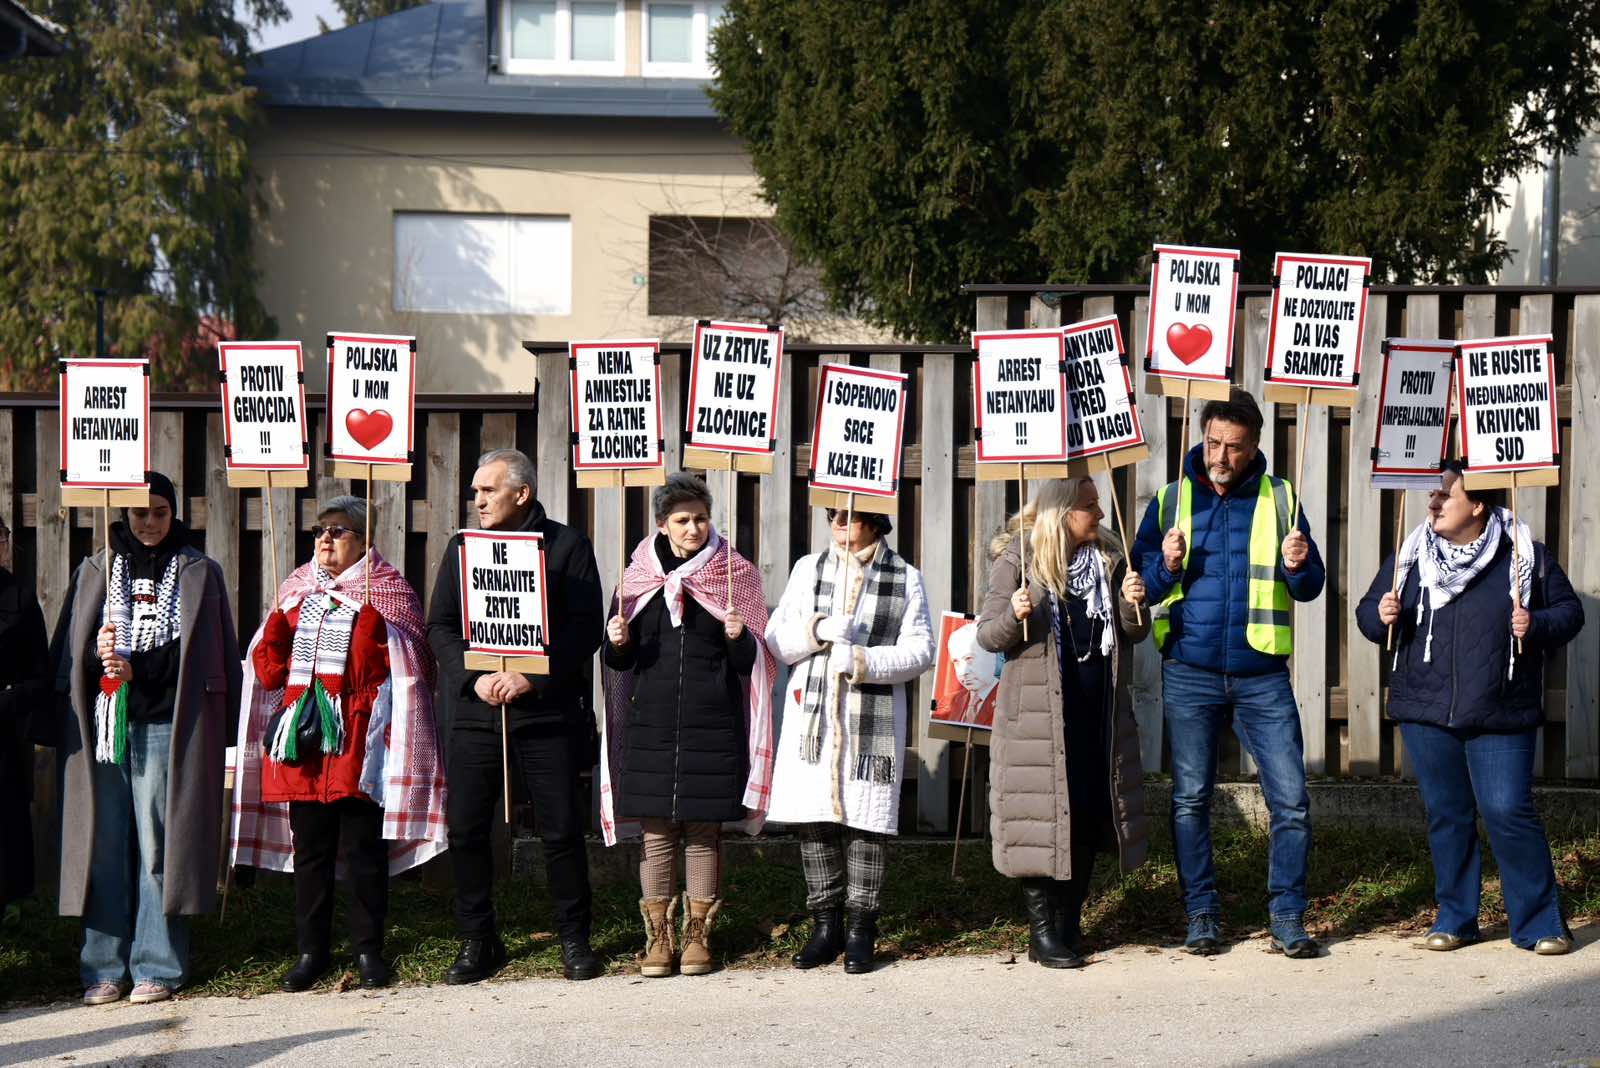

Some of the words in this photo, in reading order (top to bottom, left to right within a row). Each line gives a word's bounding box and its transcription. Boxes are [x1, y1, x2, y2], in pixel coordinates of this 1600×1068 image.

[1170, 259, 1220, 285] POLJSKA
[1296, 265, 1349, 291] POLJACI
[1175, 292, 1181, 312] U
[1186, 293, 1210, 313] MOM
[1284, 298, 1297, 317] NE
[1300, 298, 1355, 320] DOZVOLITE
[1064, 328, 1114, 361] ANYAHU
[1294, 322, 1311, 347] DA
[1315, 324, 1339, 349] VAS
[346, 346, 398, 372] POLJSKA
[598, 351, 632, 374] NEMA
[703, 334, 721, 361] UZ
[724, 332, 771, 368] ŽRTVE,
[1469, 352, 1488, 377] NE
[1492, 346, 1541, 376] RUŠITE
[998, 357, 1041, 382] ARREST
[1066, 358, 1105, 390] MORA
[1284, 350, 1344, 377] SRAMOTE
[241, 365, 284, 392] PROTIV
[352, 379, 359, 398] U
[364, 379, 389, 400] MOM
[585, 379, 651, 402] AMNESTIJE
[714, 372, 733, 398] NE
[737, 374, 755, 400] UZ
[1400, 371, 1436, 395] PROTIV
[84, 386, 127, 410] ARREST
[827, 380, 833, 403] I
[835, 377, 897, 412] ŠOPENOVO
[987, 389, 1055, 414] NETANYAHU
[1070, 386, 1106, 418] PRED
[1466, 382, 1548, 406] MEĐUNARODNI
[234, 397, 296, 423] GENOCIDA
[589, 408, 604, 431] ZA
[608, 407, 645, 430] RATNE
[697, 405, 767, 437] ZLOČINCE
[1382, 406, 1444, 427] IMPERIJALIZMA
[1476, 404, 1540, 434] KRIVIČNI
[72, 417, 139, 441] NETANYAHU
[844, 418, 874, 445] SRCE
[1016, 422, 1027, 445] !!!
[1068, 422, 1084, 447] UD
[1086, 419, 1096, 443] U
[1097, 412, 1132, 440] HAGU
[260, 431, 271, 454] !!!
[591, 432, 648, 459] ZLOČINCE
[1405, 434, 1416, 459] !!!
[1495, 437, 1524, 462] SUD
[99, 449, 111, 472] !!!
[827, 451, 858, 478] KAŽE
[861, 457, 876, 480] NE
[879, 459, 883, 481] !
[492, 542, 507, 564] NE
[472, 567, 535, 592] SKRNAVITE
[485, 593, 520, 619] ŽRTVE
[469, 621, 543, 647] HOLOKAUSTA
